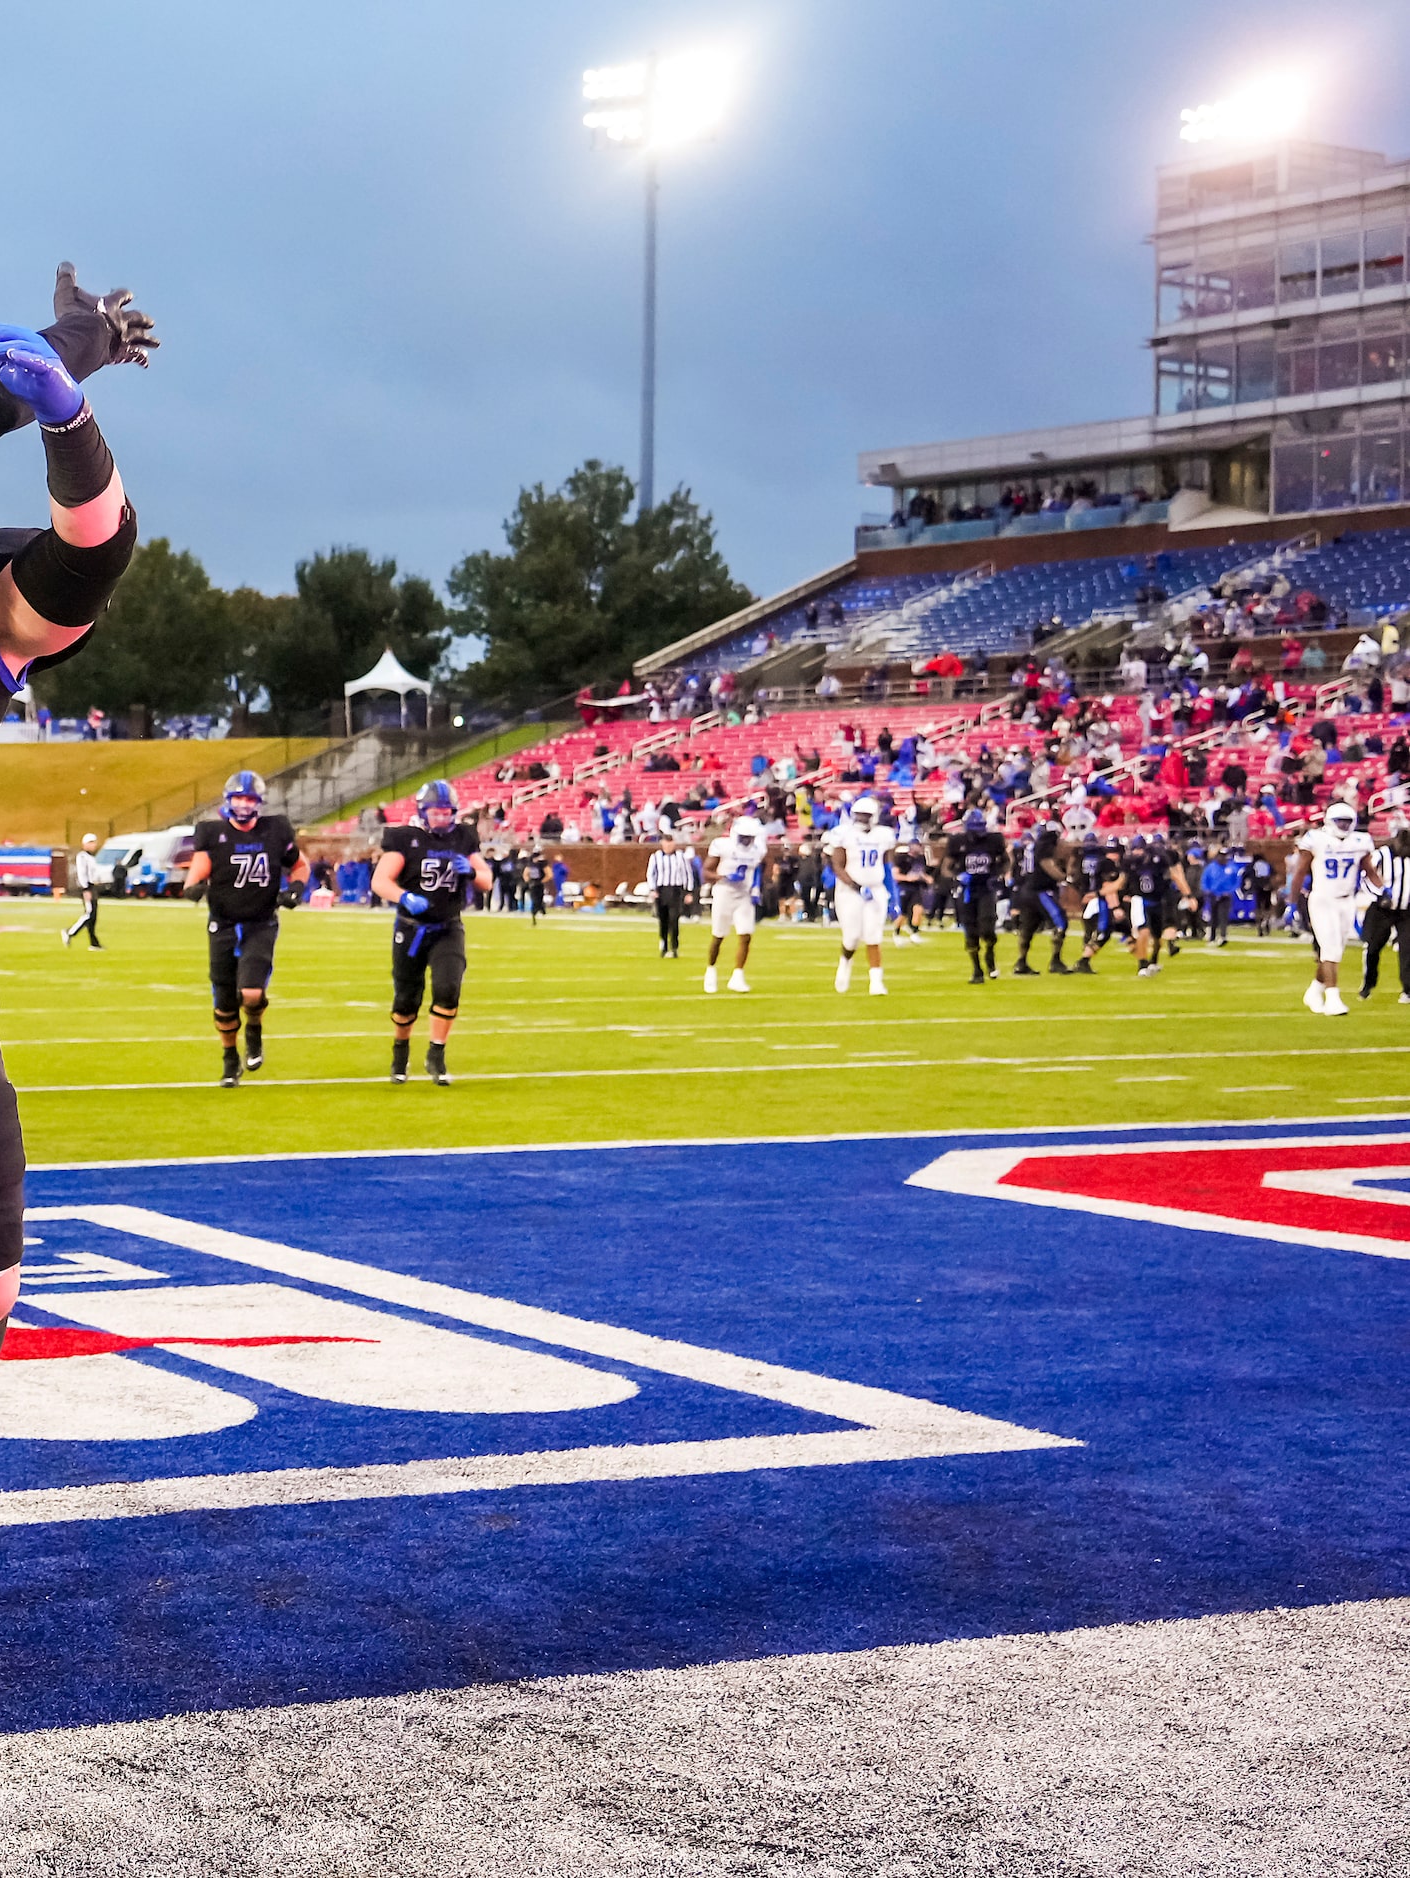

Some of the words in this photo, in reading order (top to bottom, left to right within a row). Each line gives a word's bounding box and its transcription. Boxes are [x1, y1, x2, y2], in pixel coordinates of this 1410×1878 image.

[230, 852, 270, 889] 74
[419, 857, 458, 893] 54
[1325, 857, 1355, 879] 97
